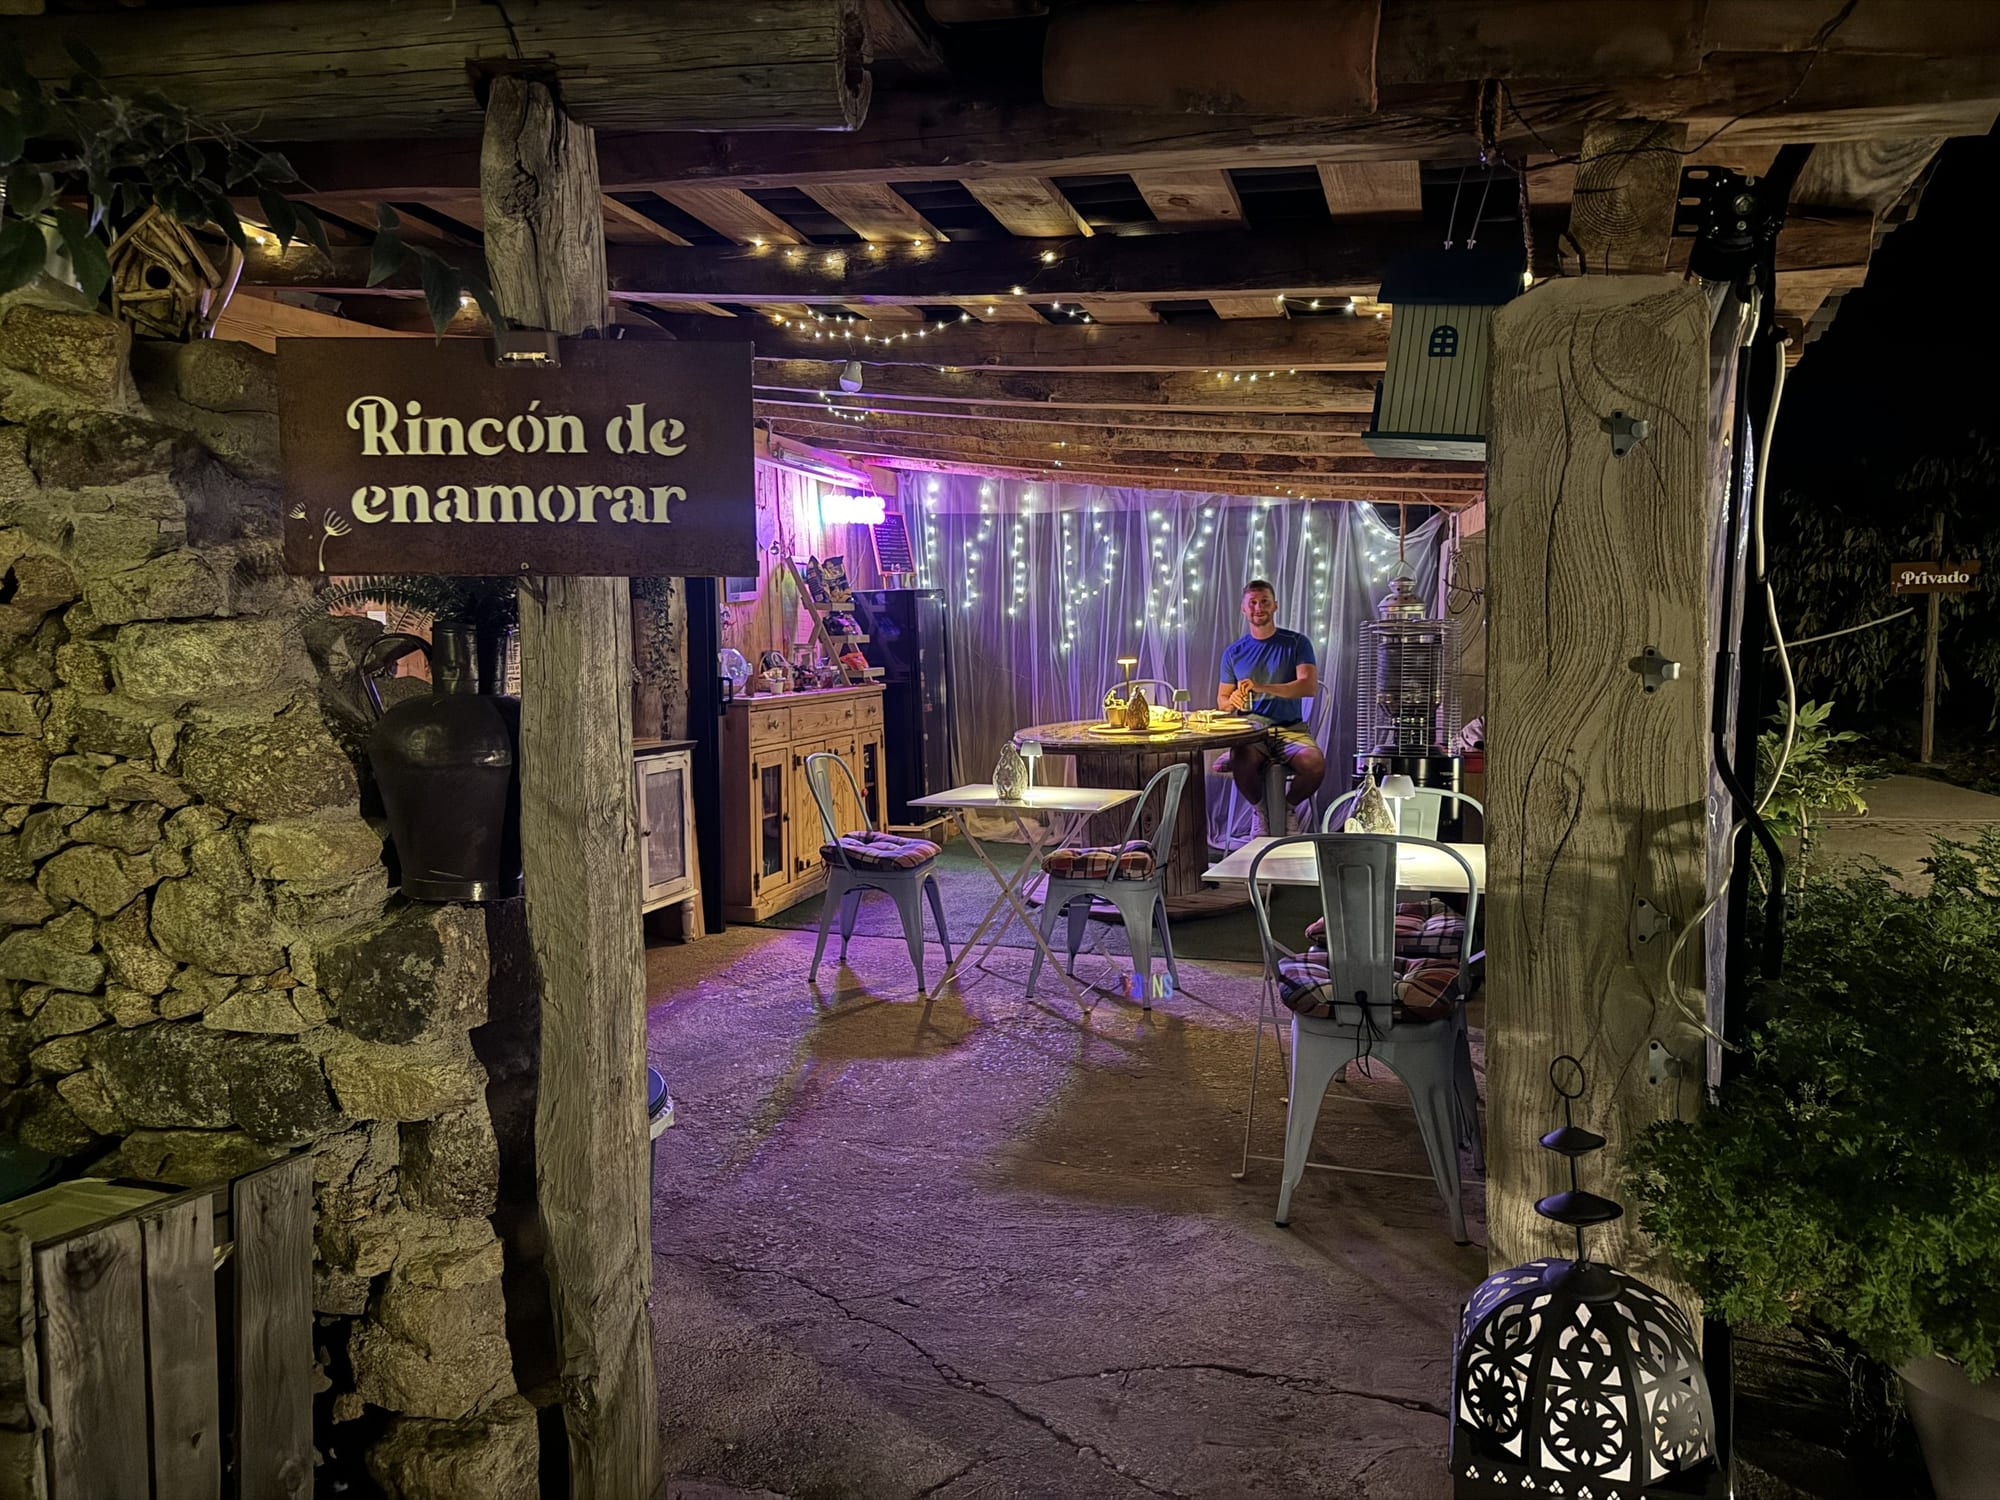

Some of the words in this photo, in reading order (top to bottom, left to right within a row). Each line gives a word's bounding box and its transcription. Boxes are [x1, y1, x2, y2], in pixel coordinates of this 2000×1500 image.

[346, 395, 588, 456] Rincón
[605, 402, 688, 457] de
[351, 484, 687, 524] enamorar
[1900, 570, 1970, 585] Privado
